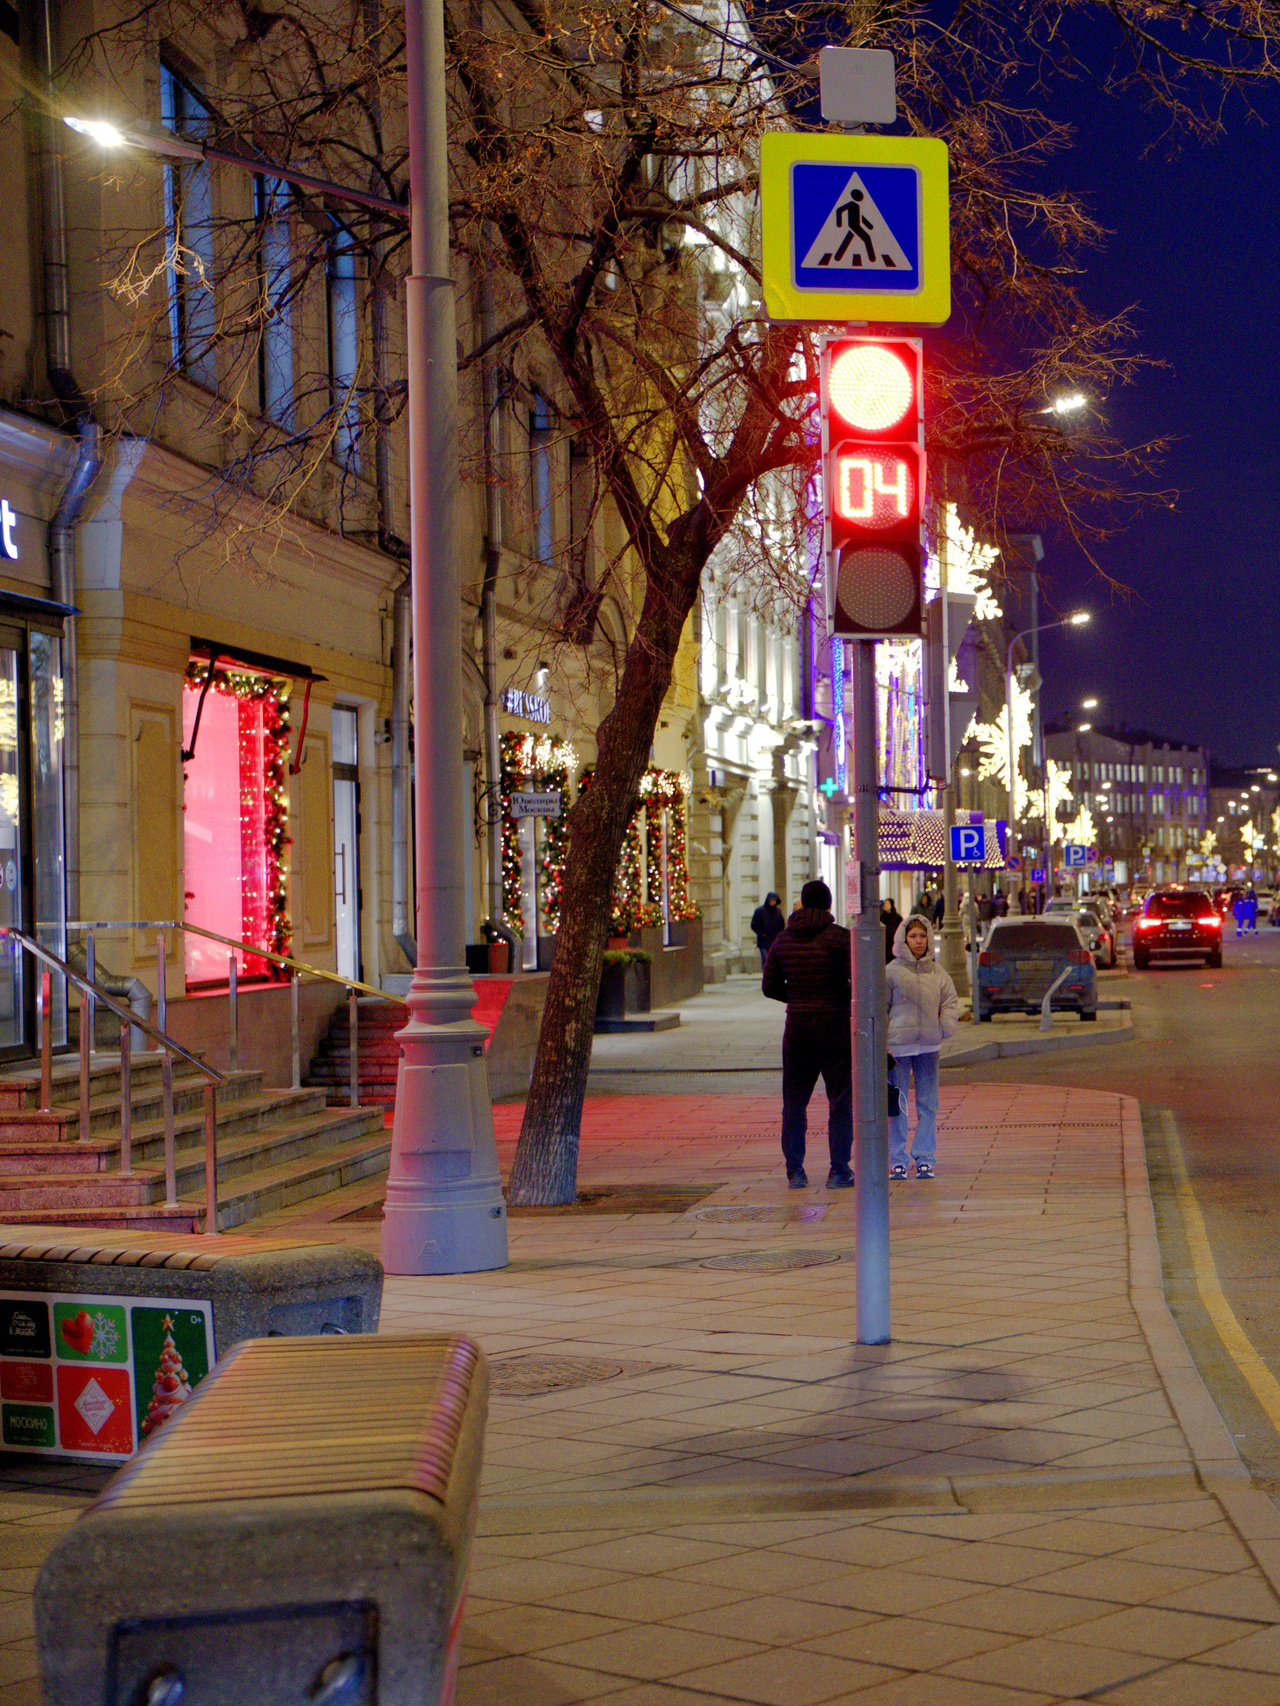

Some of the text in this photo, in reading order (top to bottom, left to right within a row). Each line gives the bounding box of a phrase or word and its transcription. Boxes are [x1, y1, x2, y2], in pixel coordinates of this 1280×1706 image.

[840, 458, 907, 517] 04
[0, 498, 19, 560] t
[512, 796, 558, 806] Ювелиры
[518, 805, 555, 814] Москвы
[960, 829, 979, 858] P
[1070, 846, 1083, 865] P
[190, 1315, 202, 1324] 0+
[9, 1415, 48, 1430] МОСКИНО
